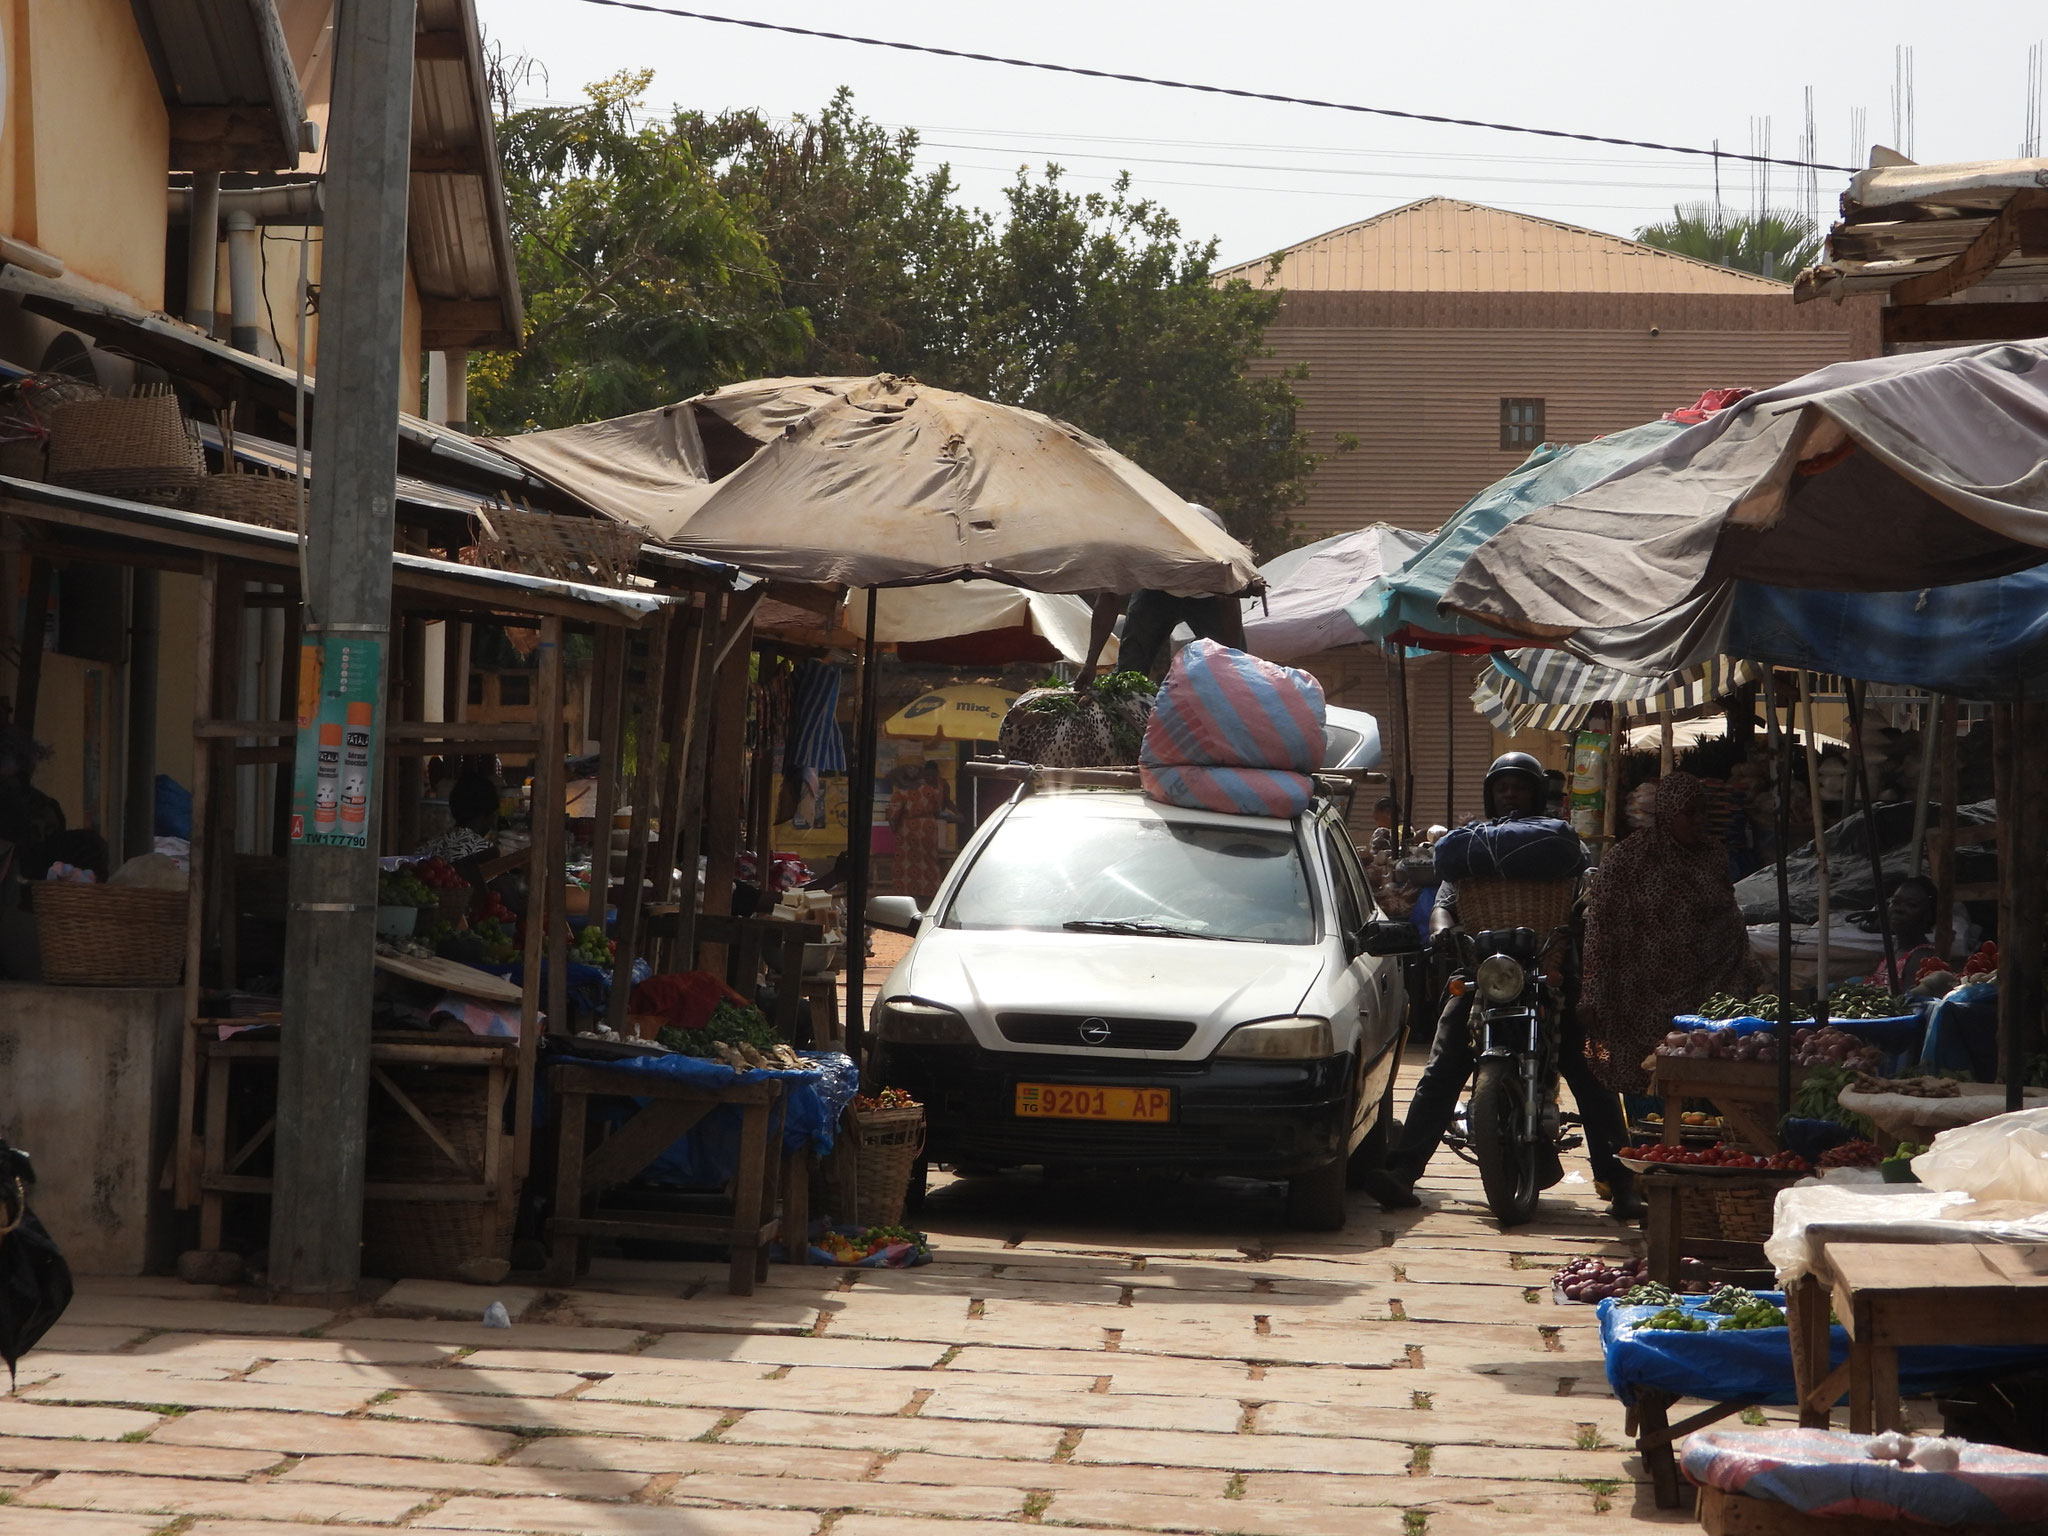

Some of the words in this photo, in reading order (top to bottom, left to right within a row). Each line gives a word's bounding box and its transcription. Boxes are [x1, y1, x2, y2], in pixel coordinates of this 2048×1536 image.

[347, 733, 369, 746] FATALA
[305, 833, 366, 847] TW177790
[1023, 1103, 1039, 1113] TG
[1042, 1089, 1107, 1116] 9201
[1132, 1093, 1165, 1118] AP
